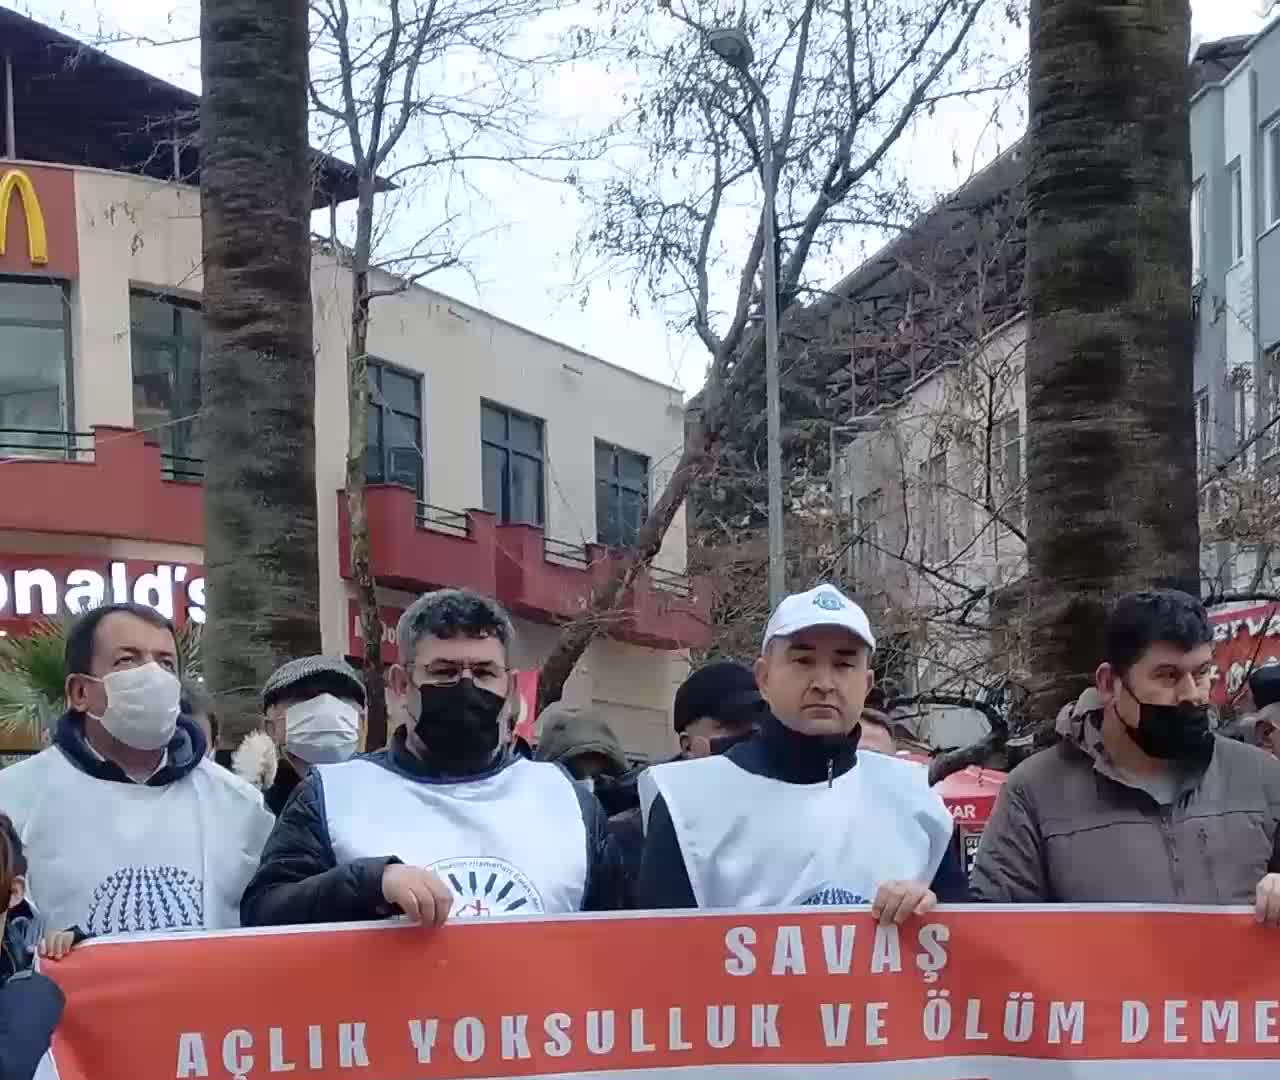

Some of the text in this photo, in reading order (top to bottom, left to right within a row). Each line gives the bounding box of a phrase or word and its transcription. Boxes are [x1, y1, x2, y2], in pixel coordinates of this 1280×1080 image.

[723, 922, 951, 983] SAVAŞ
[408, 1003, 782, 1065] YOKSULLUK
[819, 1001, 890, 1048] VE
[922, 988, 1086, 1045] ÖLÜM
